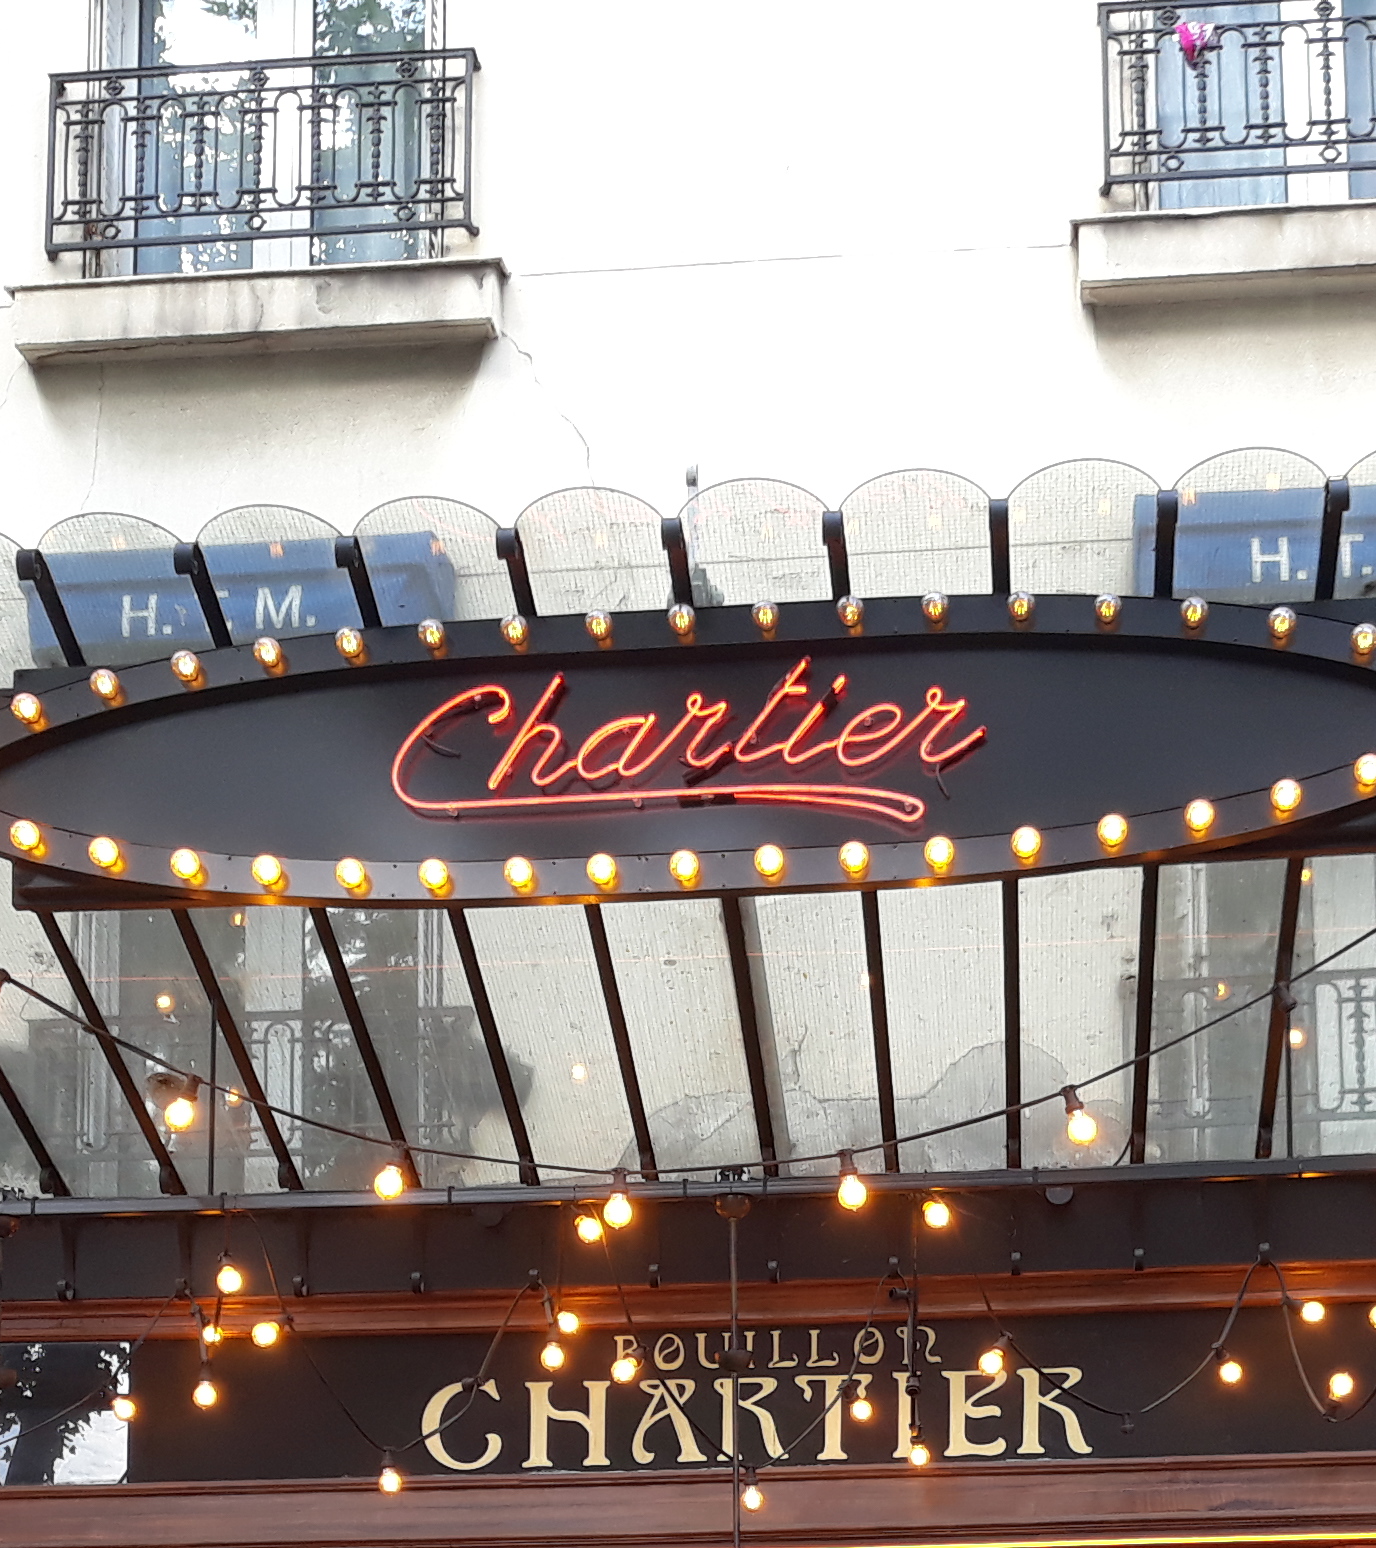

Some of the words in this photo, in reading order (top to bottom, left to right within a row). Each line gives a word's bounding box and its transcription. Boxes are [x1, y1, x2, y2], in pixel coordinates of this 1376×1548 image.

[391, 658, 988, 820] Chartier
[613, 1325, 945, 1370] BOUILLON
[420, 1366, 1094, 1471] CHARTIER
